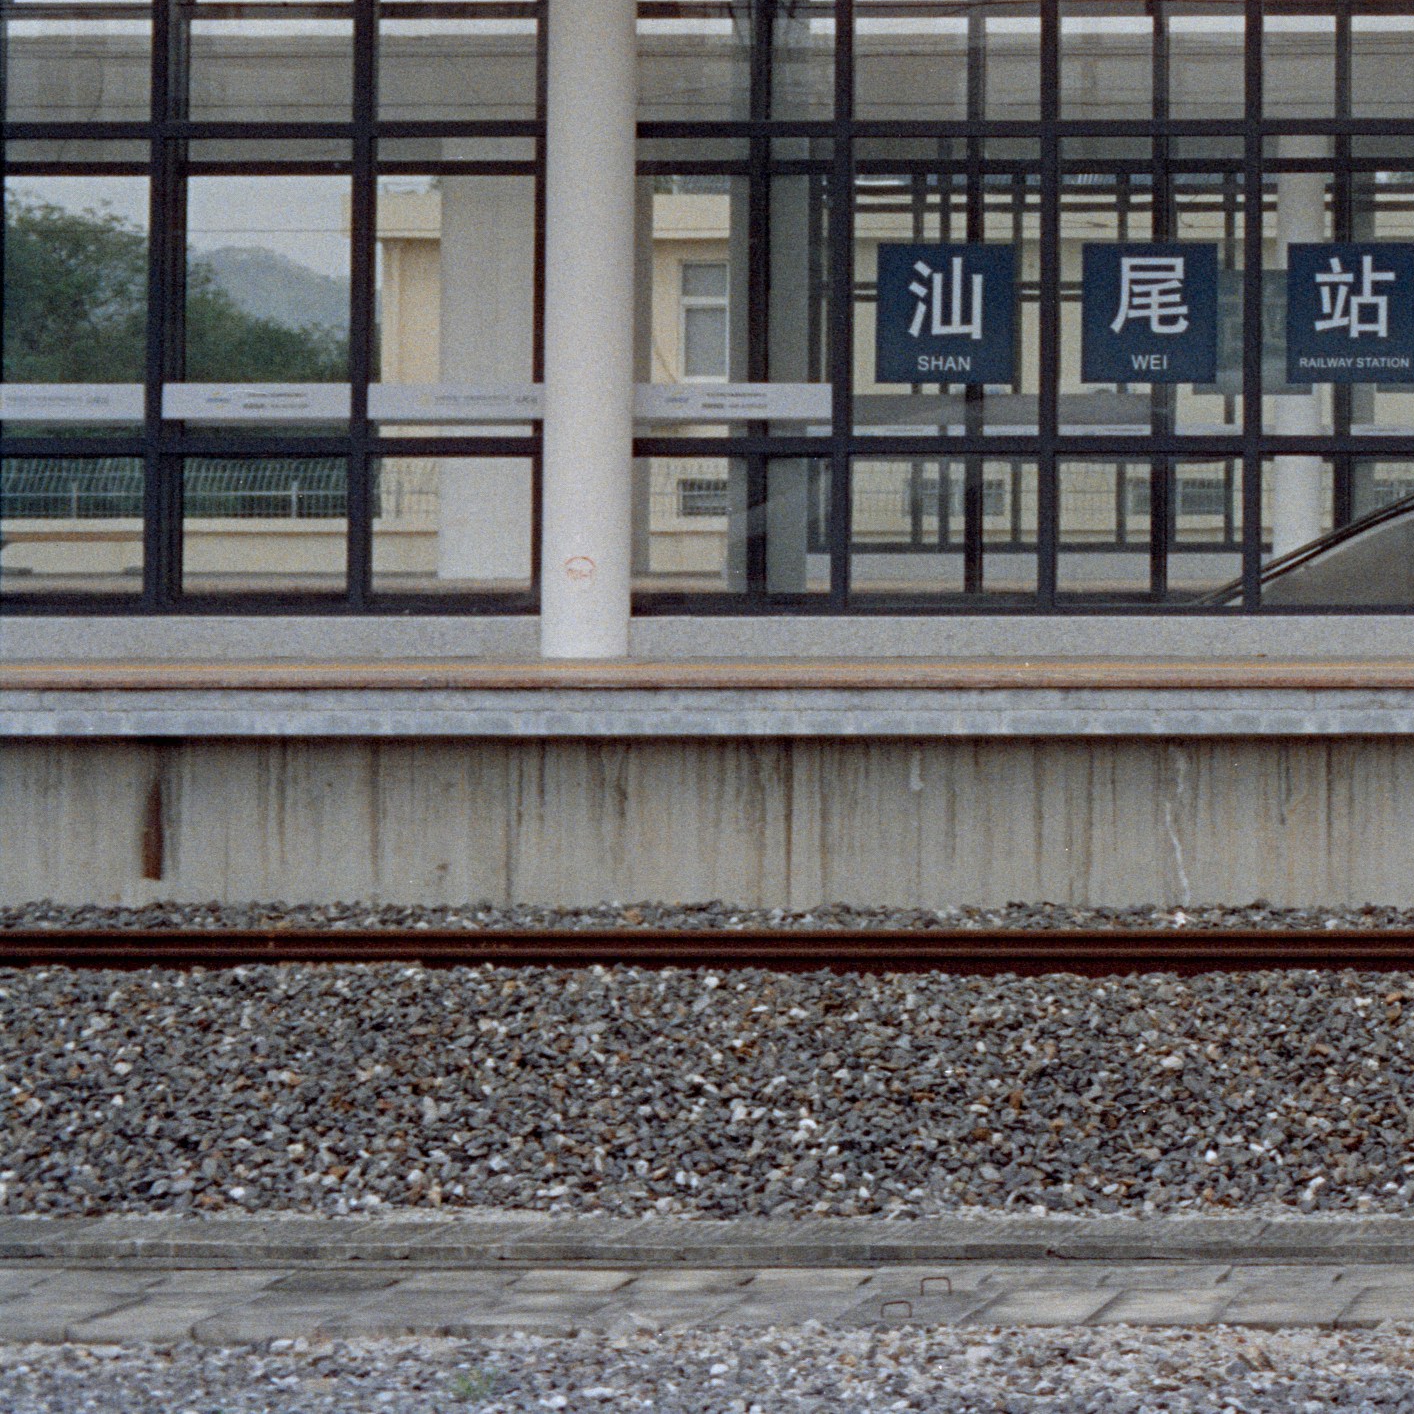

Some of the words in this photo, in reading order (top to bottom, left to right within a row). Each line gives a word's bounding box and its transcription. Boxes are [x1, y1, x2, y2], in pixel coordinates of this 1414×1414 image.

[908, 257, 983, 338] 汕
[1110, 257, 1189, 334] 尾
[1314, 255, 1395, 338] 站
[917, 356, 972, 371] SHAN
[1131, 354, 1168, 370] WEI
[1299, 357, 1353, 368] RAILWAY
[1356, 357, 1410, 368] STATION
